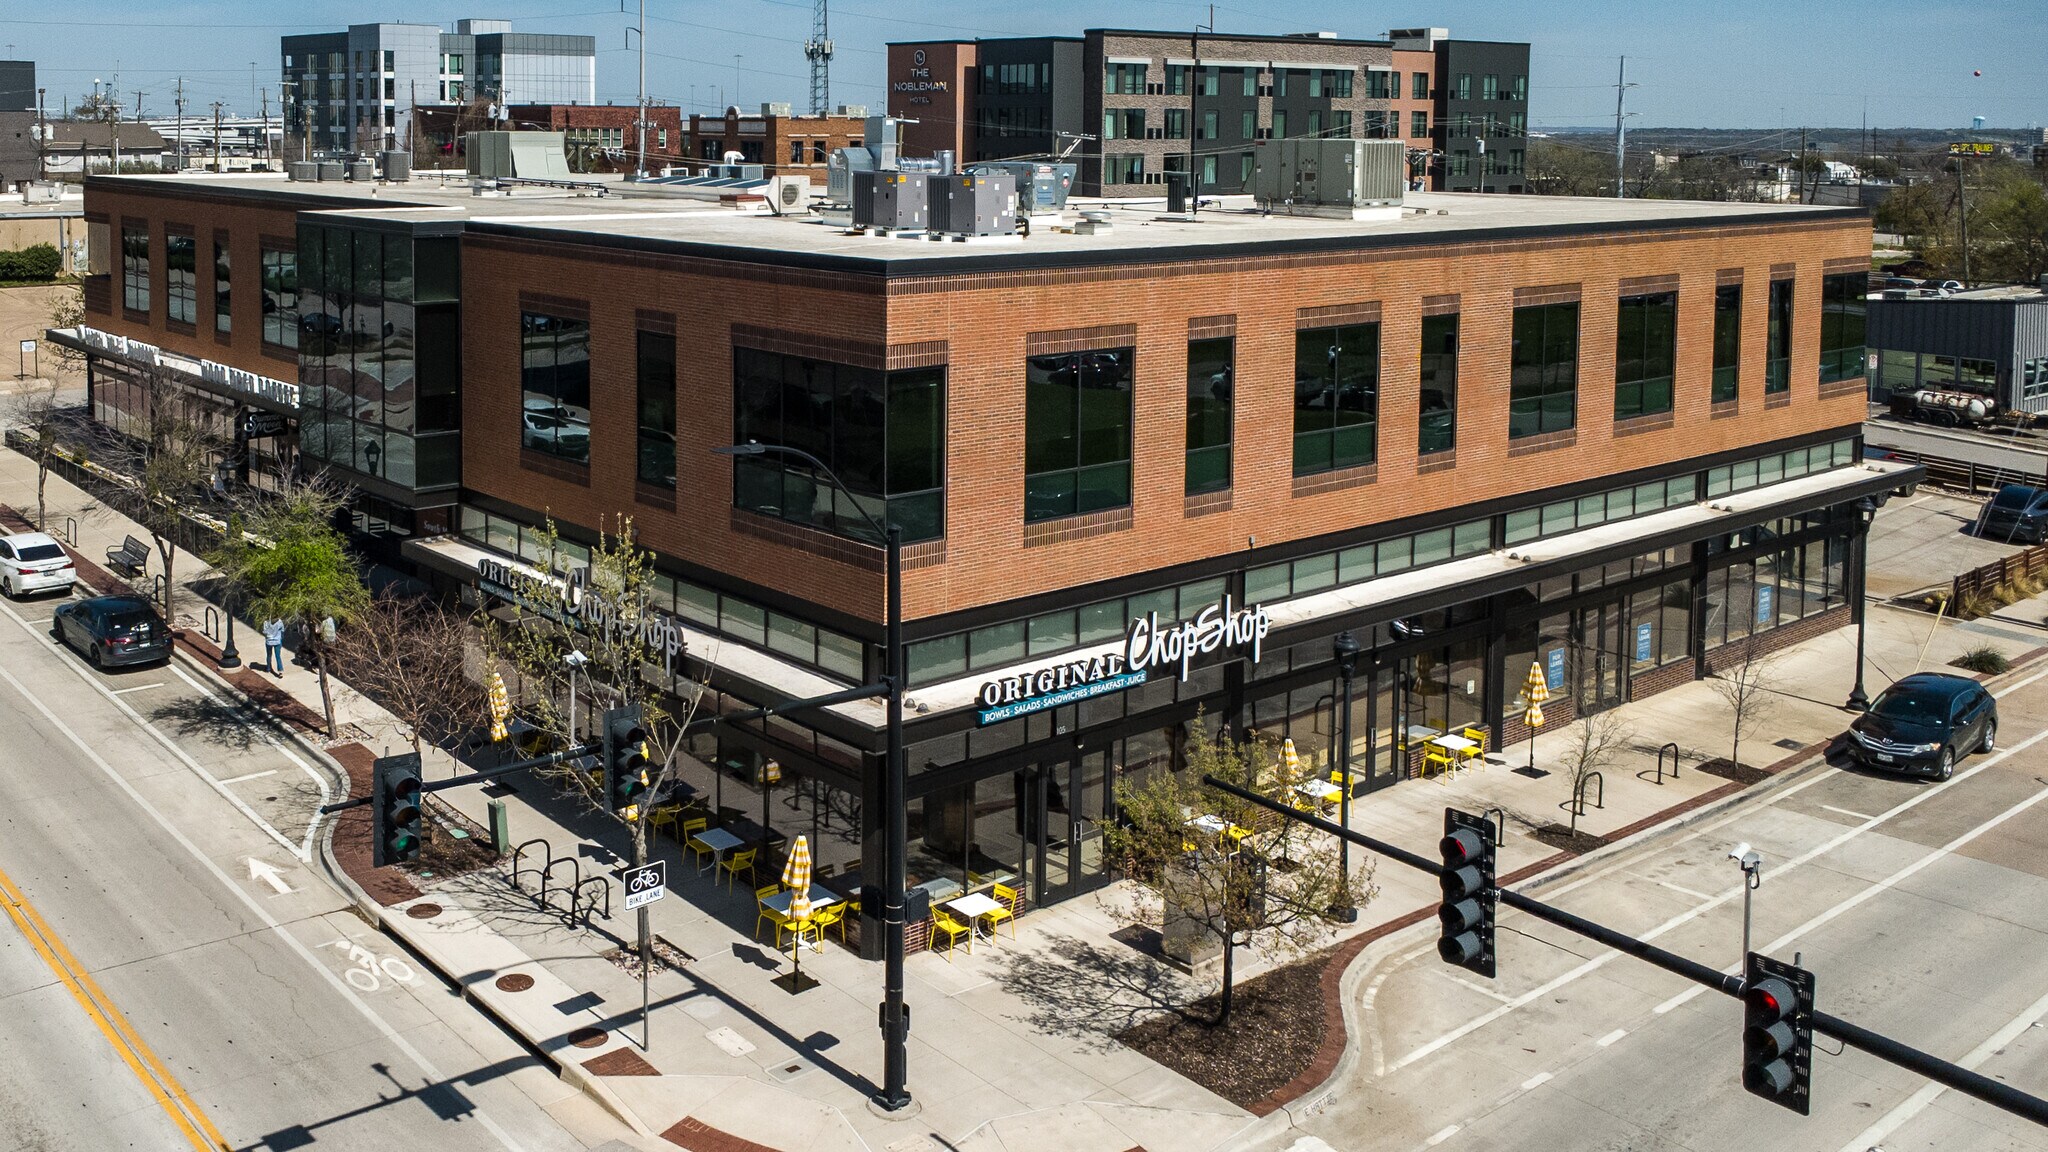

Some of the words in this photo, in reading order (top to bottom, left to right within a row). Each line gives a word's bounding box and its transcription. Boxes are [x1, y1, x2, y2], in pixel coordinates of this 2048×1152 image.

[911, 68, 929, 77] THE
[894, 82, 947, 91] NOBLEMAN
[984, 655, 1123, 706] ORIGINAL
[985, 708, 1010, 722] BOWLS
[1014, 700, 1041, 714] SALADS
[1043, 688, 1088, 706] SANDWICHES
[1090, 680, 1124, 694] BREAKFAST
[1127, 672, 1146, 685] JUICE
[629, 895, 642, 905] BIKE
[646, 889, 660, 900] LANE
